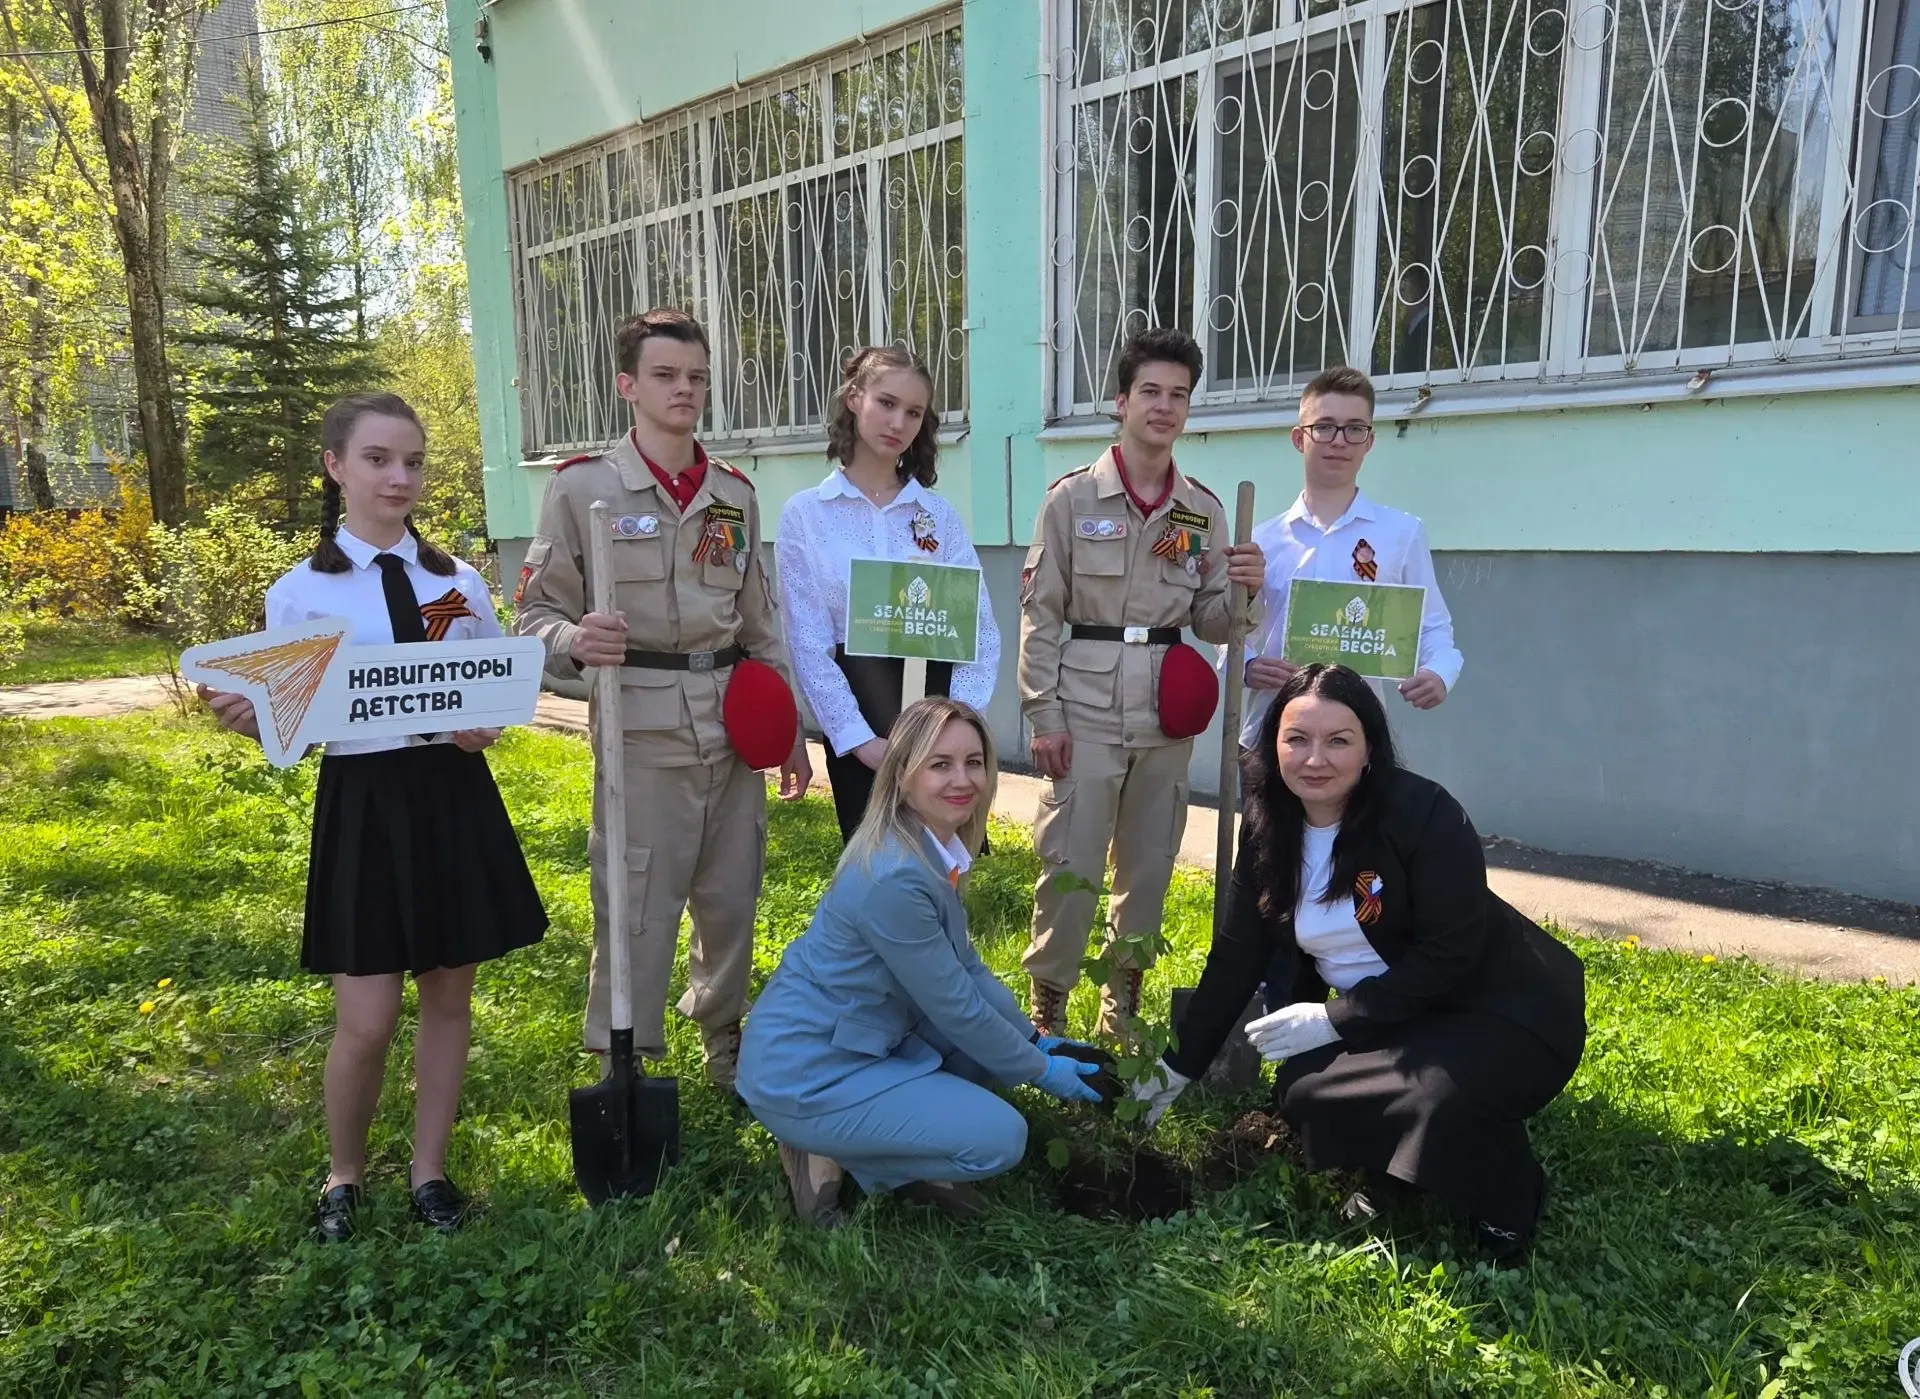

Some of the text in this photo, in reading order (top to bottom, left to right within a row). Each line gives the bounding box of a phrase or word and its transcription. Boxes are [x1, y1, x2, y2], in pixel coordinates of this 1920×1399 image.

[904, 621, 958, 638] ВЕСНА
[1339, 639, 1396, 657] ВЕСНА
[349, 657, 512, 690] НАВИГАТОРЫ
[349, 690, 463, 722] ДЕТСТВА
